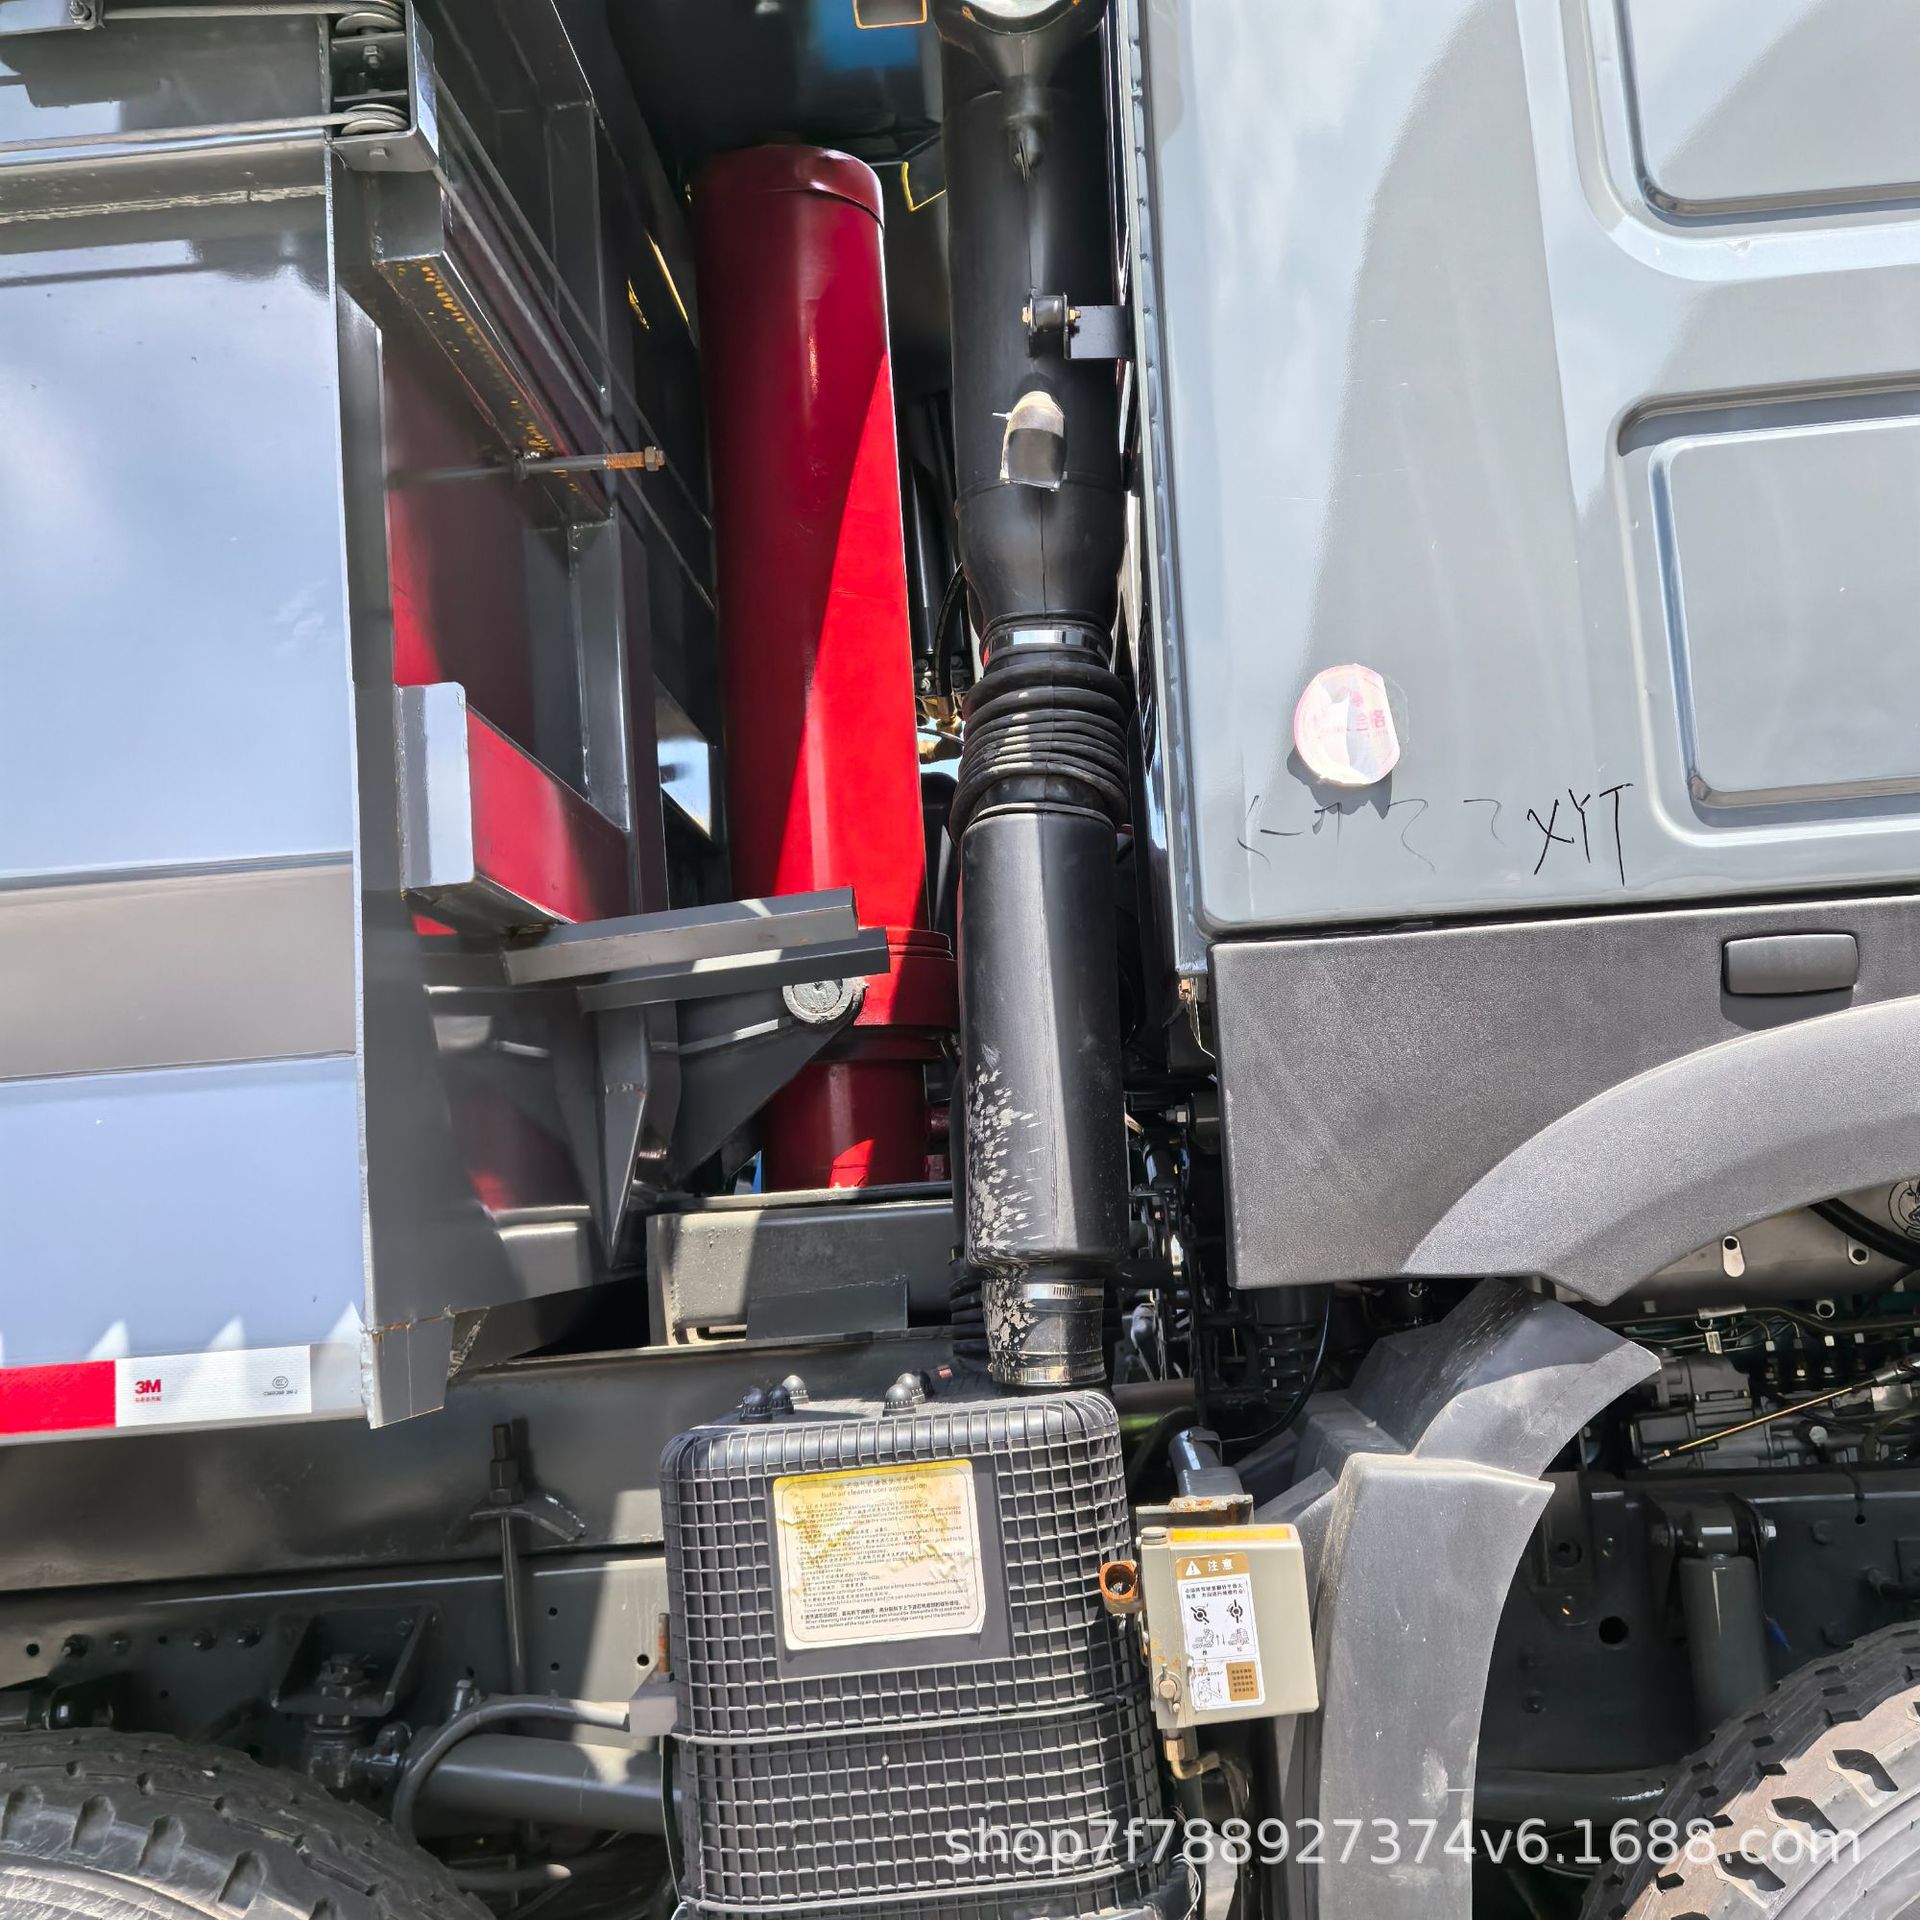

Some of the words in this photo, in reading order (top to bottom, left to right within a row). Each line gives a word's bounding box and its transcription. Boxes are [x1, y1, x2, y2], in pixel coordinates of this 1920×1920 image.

[1527, 783, 1634, 886] XYT
[135, 1379, 161, 1394] 3M
[1207, 1558, 1233, 1573] 注意
